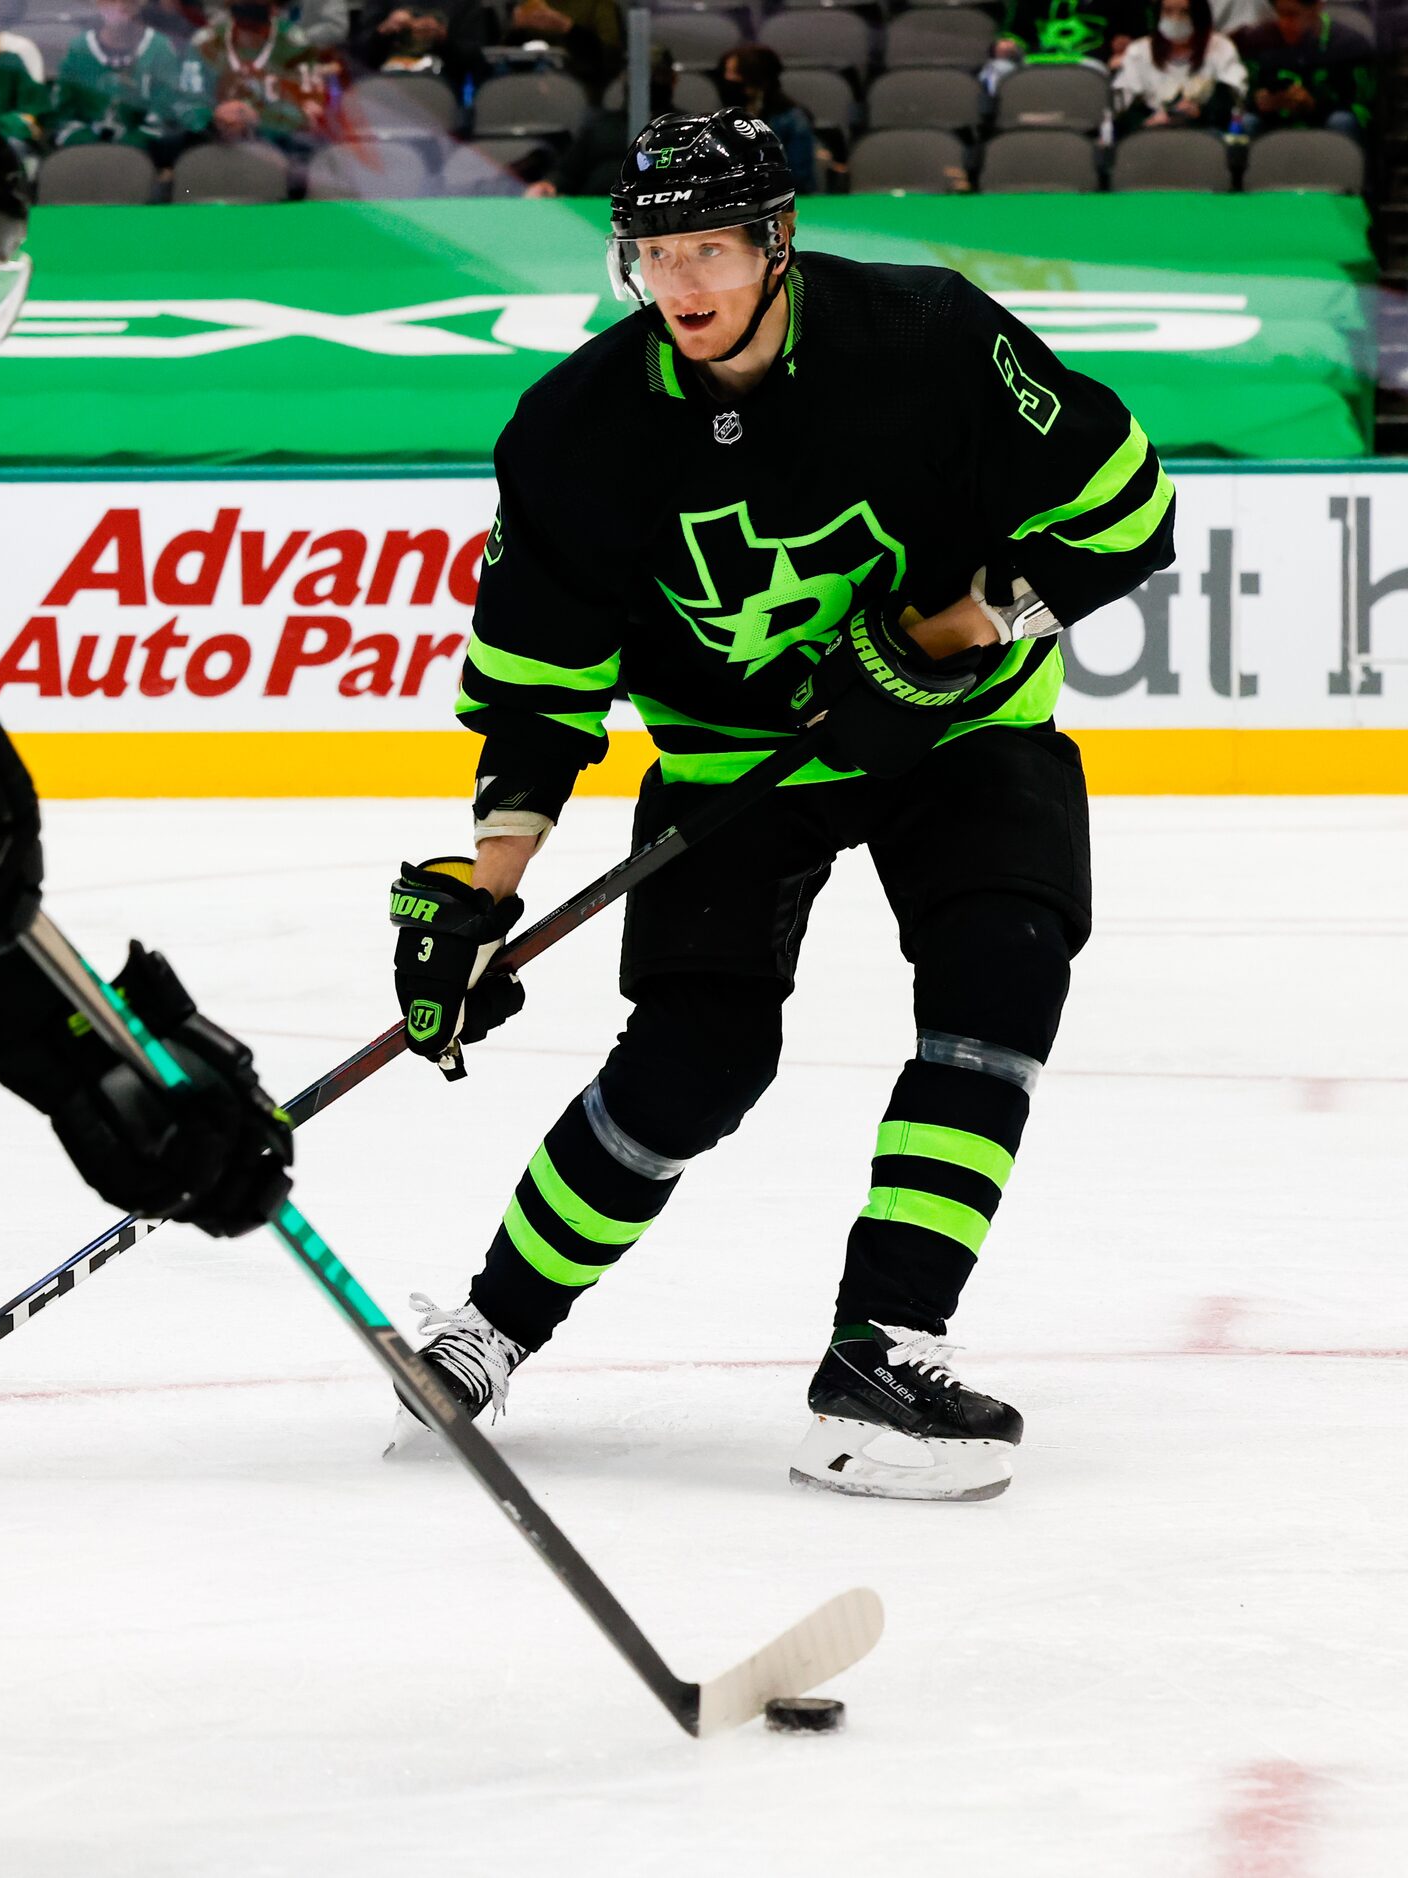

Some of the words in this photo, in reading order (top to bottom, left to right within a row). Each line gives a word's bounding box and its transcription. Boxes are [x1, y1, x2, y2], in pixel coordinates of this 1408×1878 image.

[656, 147, 674, 169] 3
[636, 189, 692, 206] CCM
[992, 333, 1062, 436] 3
[849, 608, 965, 707] WARRIOR
[417, 936, 434, 962] 3
